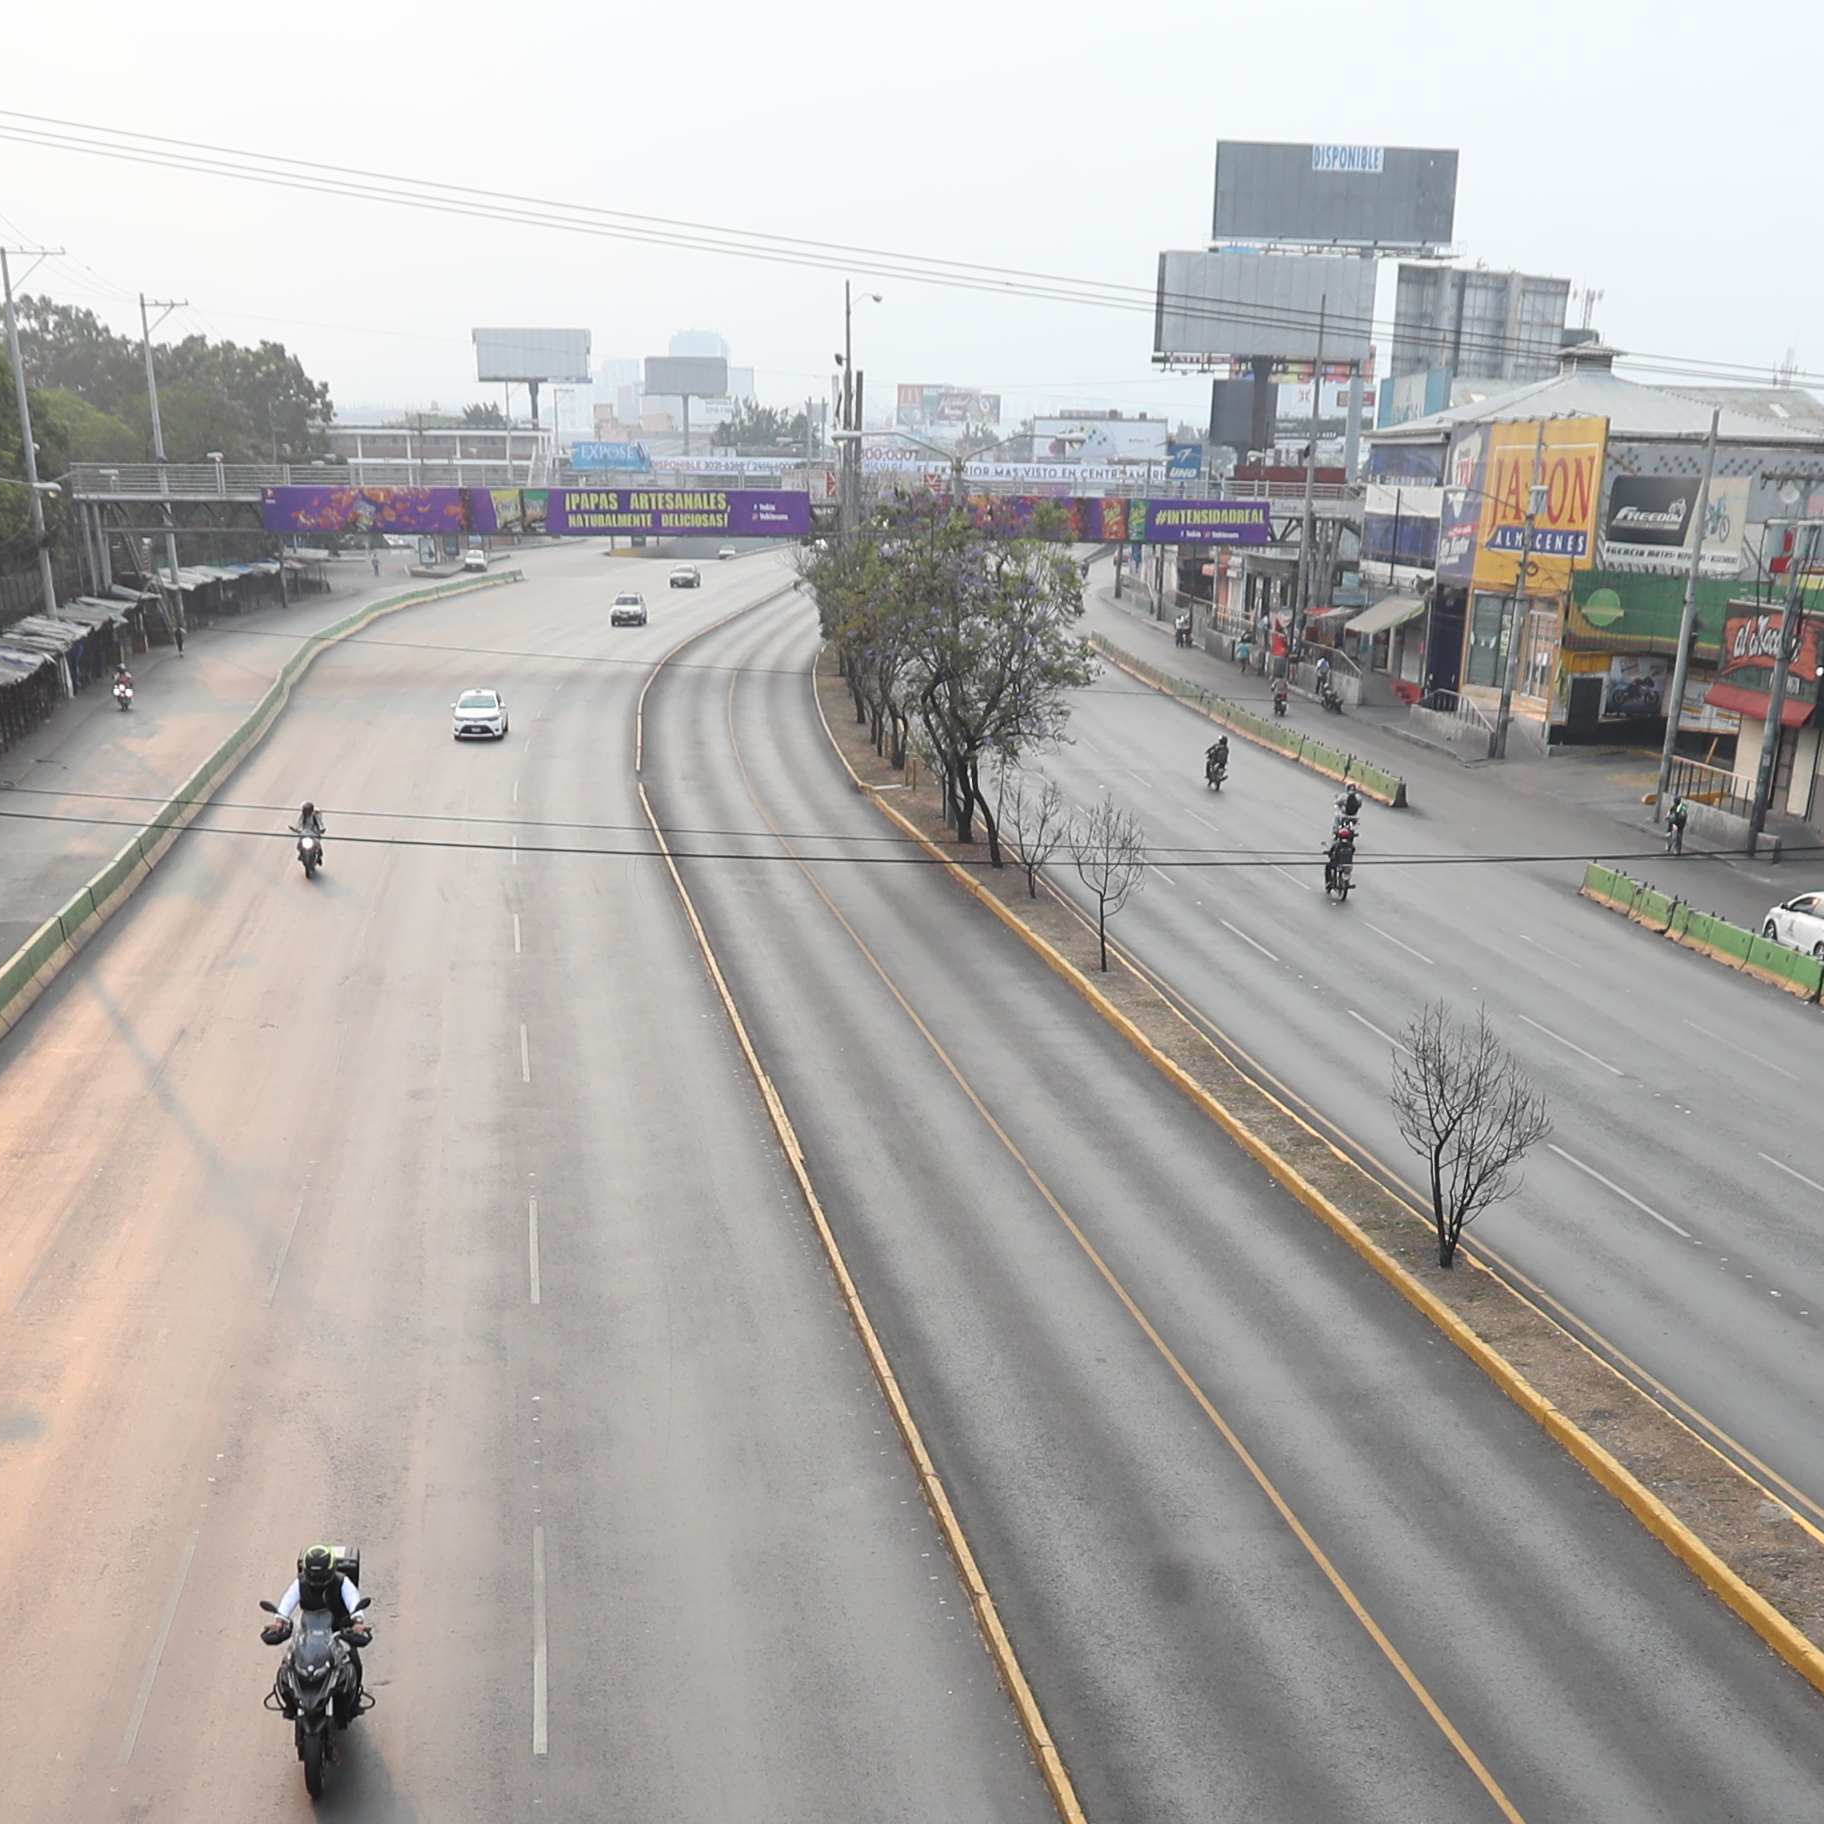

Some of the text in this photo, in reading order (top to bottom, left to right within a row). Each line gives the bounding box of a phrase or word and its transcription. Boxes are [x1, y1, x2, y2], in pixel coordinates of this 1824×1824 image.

[1314, 145, 1380, 169] DISPONIBLE
[1169, 467, 1197, 479] UNO
[568, 513, 653, 528] NATURALMENTE
[1155, 508, 1265, 526] #INTENSIDADREAL
[1495, 530, 1585, 552] ALMCENES
